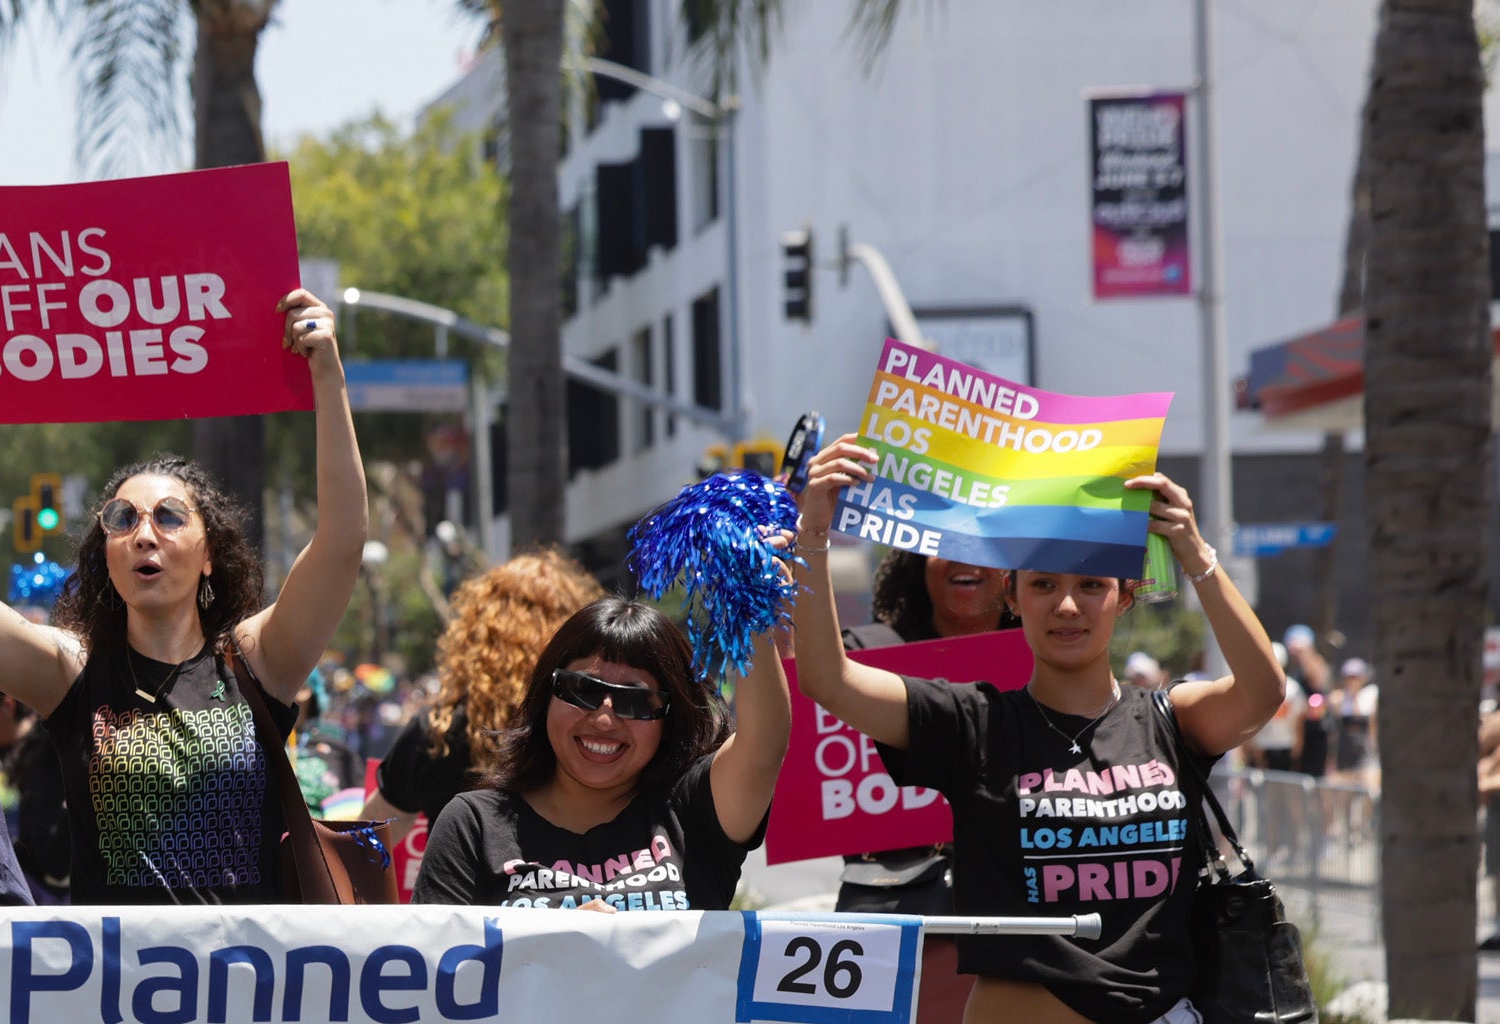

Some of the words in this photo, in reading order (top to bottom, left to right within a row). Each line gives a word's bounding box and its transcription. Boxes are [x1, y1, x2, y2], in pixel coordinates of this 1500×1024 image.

[78, 272, 233, 328] OUR
[884, 346, 1040, 421] PLANNED
[865, 412, 932, 455] LOS
[874, 379, 1103, 455] PARENTHOOD
[846, 481, 918, 521] HAS
[857, 447, 1011, 509] ANGELES
[838, 506, 942, 557] PRIDE
[815, 734, 879, 773] OF
[821, 772, 951, 821] BOD
[1019, 758, 1176, 797] PLANNED
[1019, 790, 1188, 819] PARENTHOOD
[1020, 826, 1073, 849] LOS
[1077, 817, 1188, 849] ANGELES
[503, 834, 672, 884] PANNED
[507, 862, 681, 893] PARENTHOOD
[1023, 866, 1040, 904] HAS
[776, 936, 865, 999] 26
